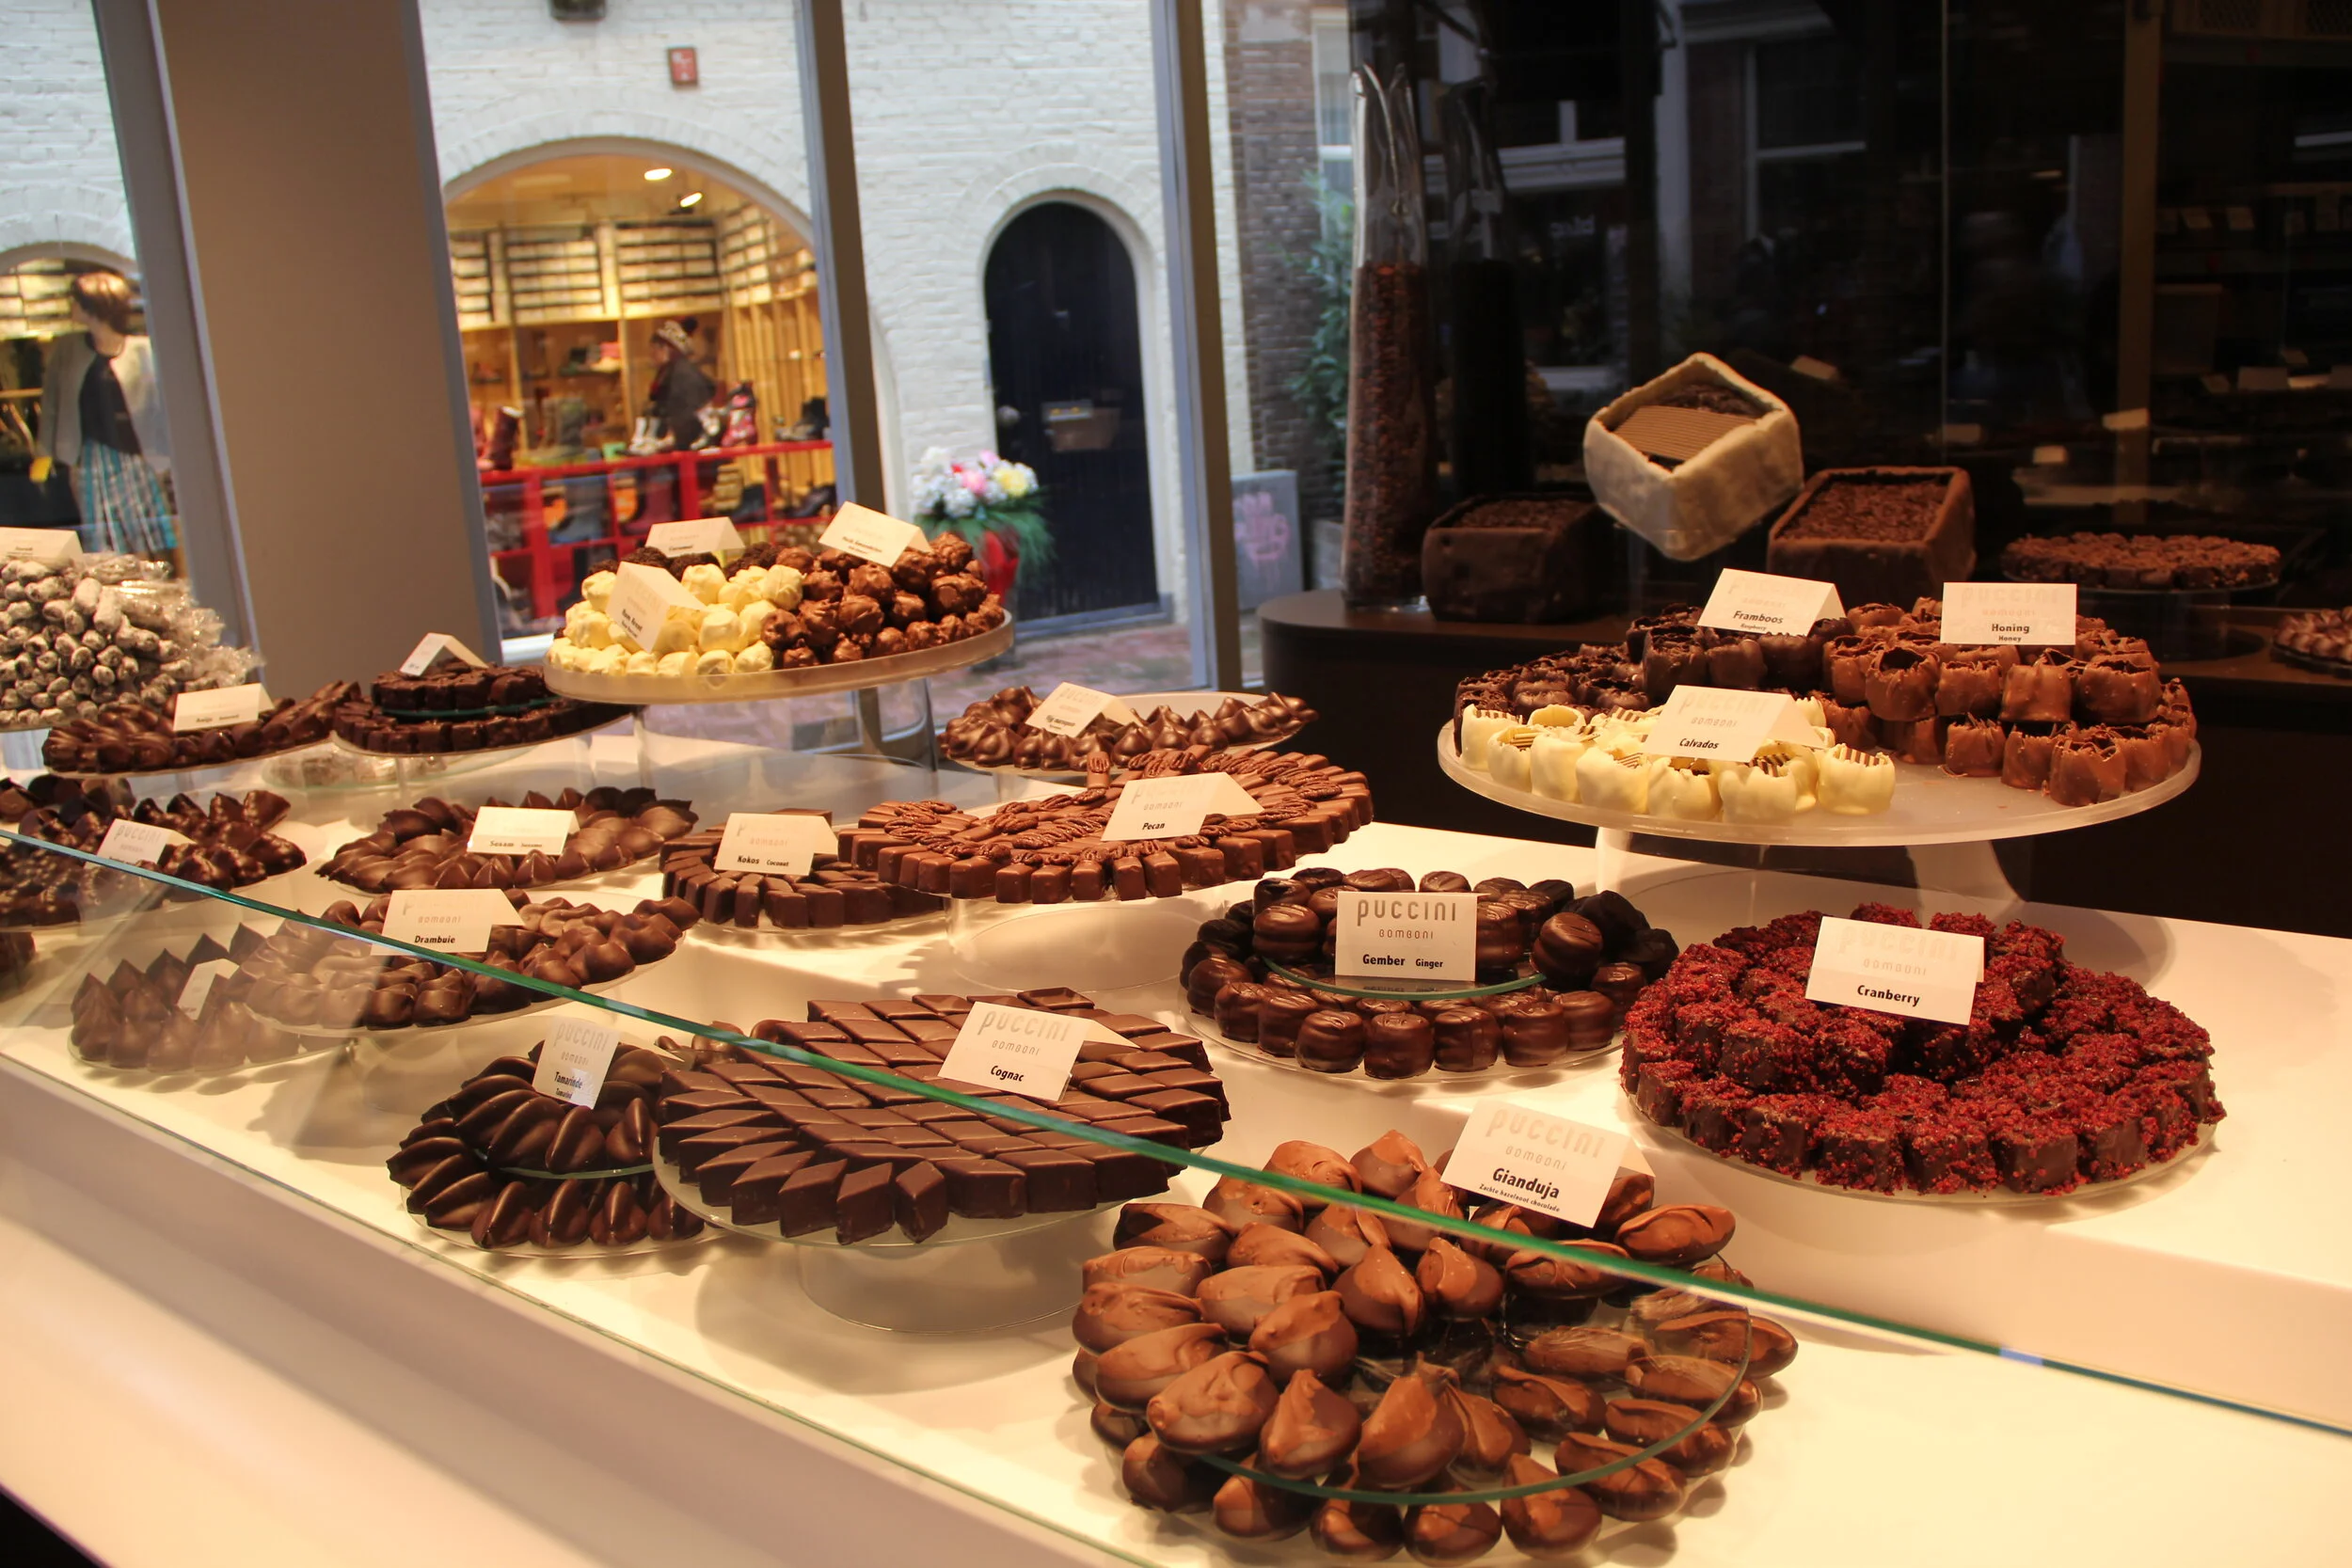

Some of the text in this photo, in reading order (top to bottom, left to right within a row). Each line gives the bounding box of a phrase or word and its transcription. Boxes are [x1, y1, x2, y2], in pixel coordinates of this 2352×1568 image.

[1733, 610, 1784, 624] Framboos
[1992, 624, 2030, 633] Honing
[1679, 737, 1720, 750] Calvados
[1141, 822, 1166, 831] Pecan
[737, 855, 759, 864] Kokos
[414, 935, 455, 943] Drambuie
[1362, 954, 1444, 970] Gember Ginger
[1857, 985, 1920, 1007] Cranberry
[554, 1071, 583, 1089] Tamarinde
[991, 1065, 1025, 1082] Cognac
[556, 1087, 573, 1100] Tamarind
[1492, 1167, 1560, 1199] Gianduja
[1479, 1183, 1561, 1212] Zachte hazelnoot chocolade
